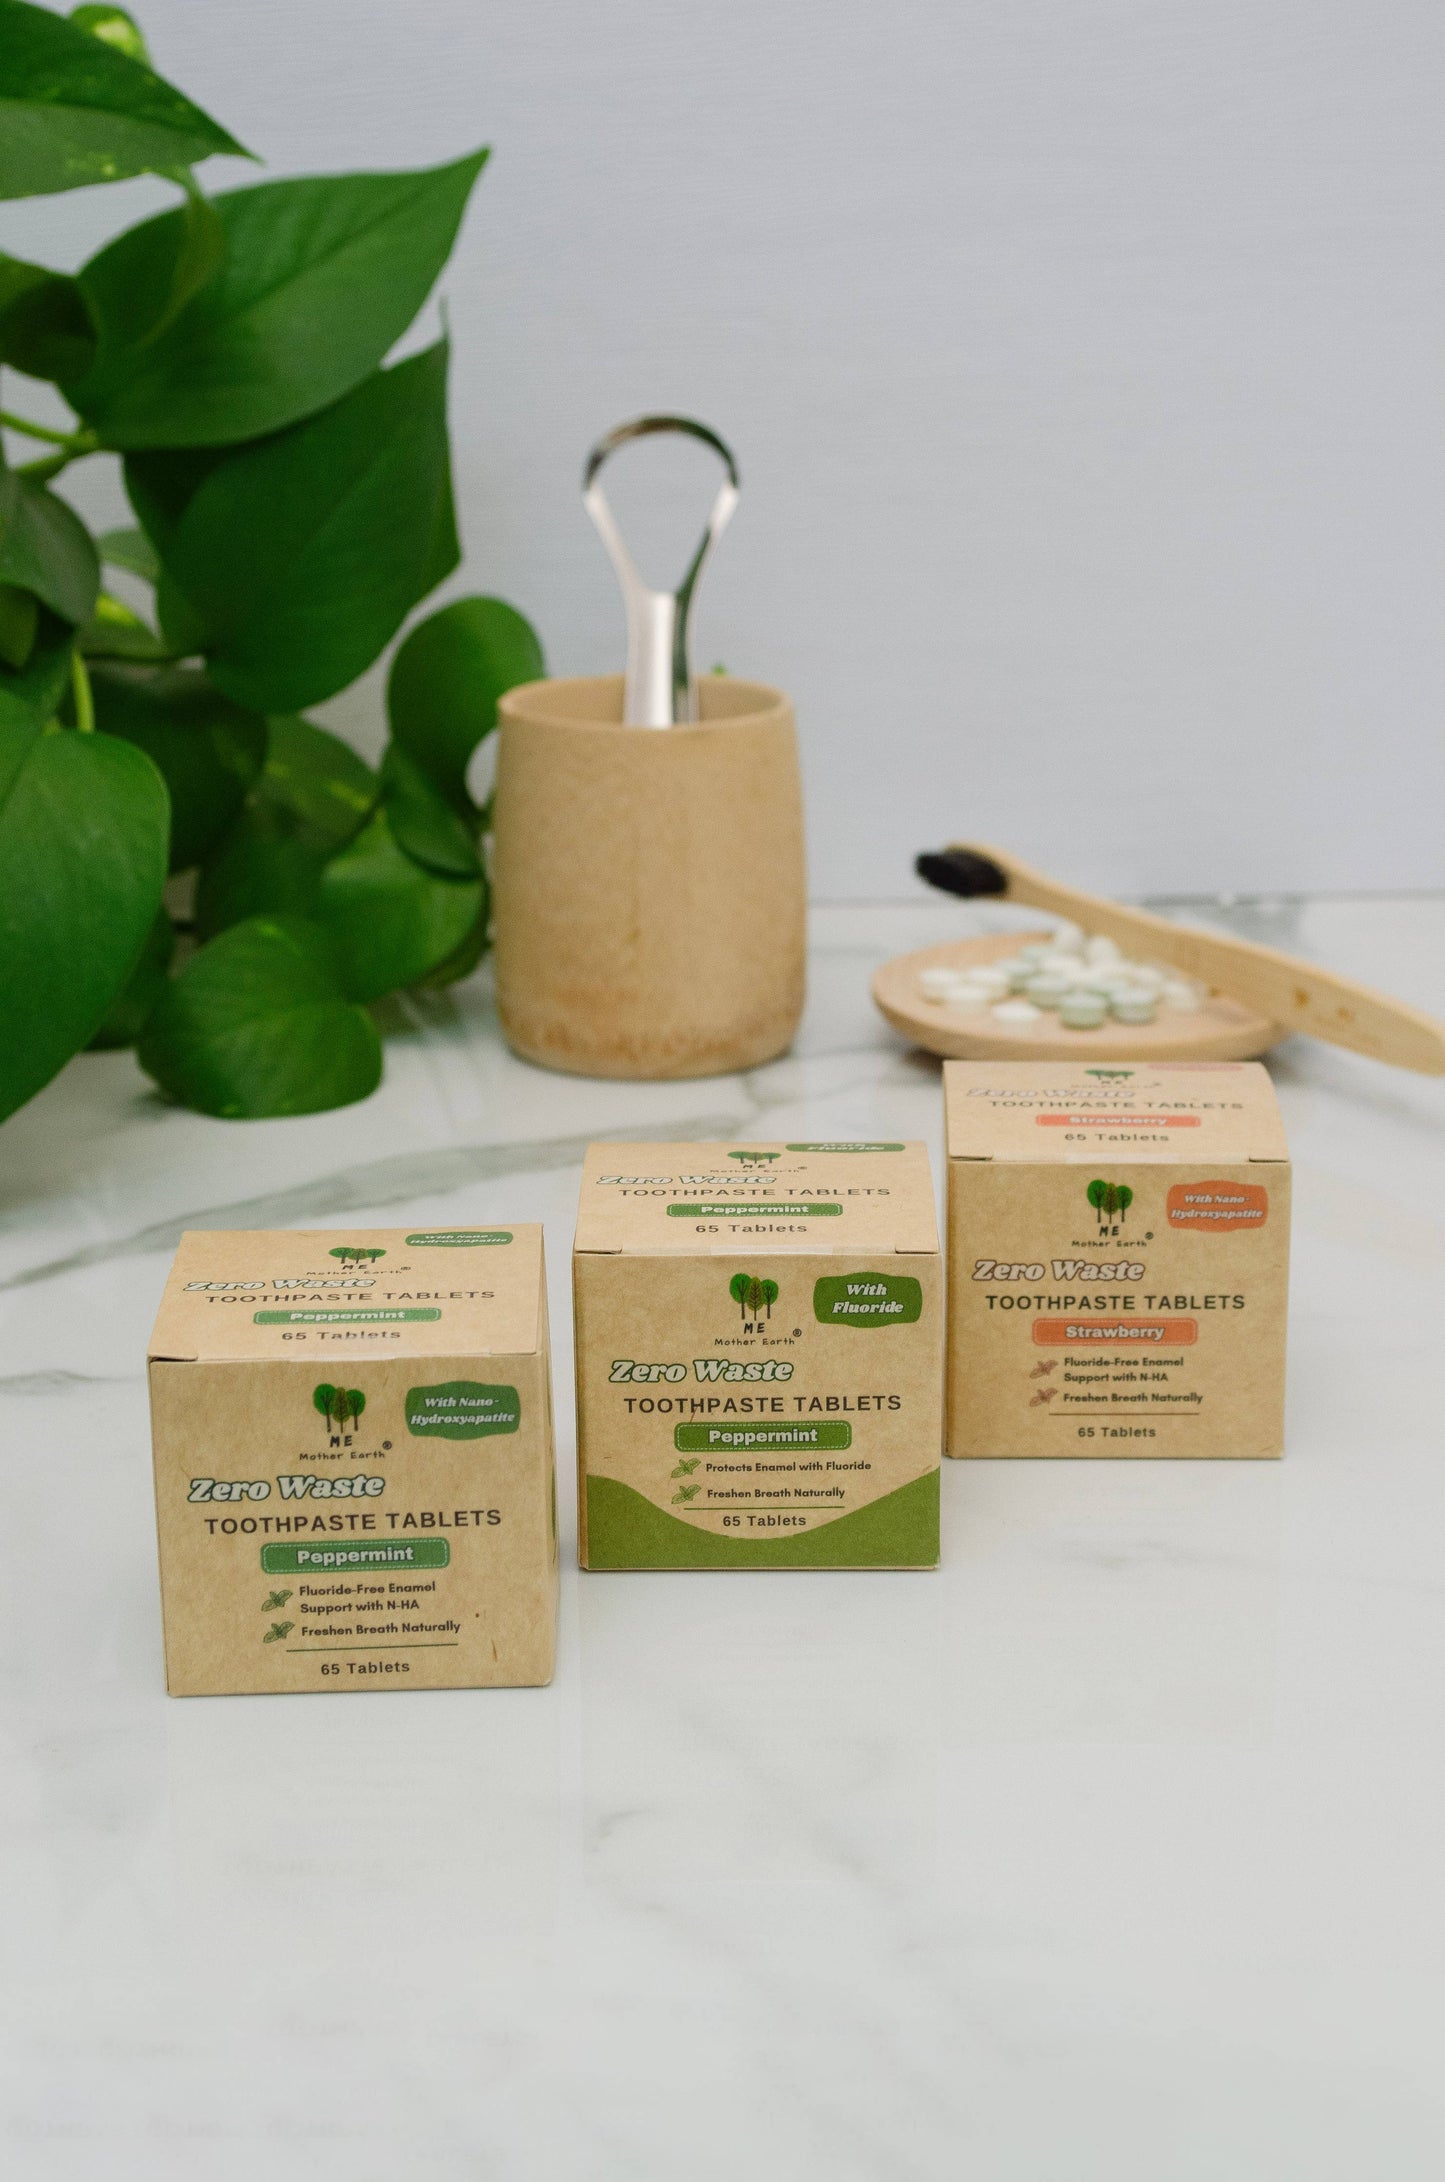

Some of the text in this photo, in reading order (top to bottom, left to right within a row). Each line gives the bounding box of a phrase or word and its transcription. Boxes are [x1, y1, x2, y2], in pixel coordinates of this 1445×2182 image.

[989, 1101, 1136, 1109] TOOTHPASTE
[1069, 1117, 1168, 1127] Strawberry
[596, 1175, 777, 1185] Zero Waste
[788, 1188, 891, 1196] TABLETS
[1184, 1194, 1214, 1204] With
[701, 1205, 809, 1215] Peppermint
[1171, 1208, 1263, 1220] Hydroxyapatite
[696, 1224, 808, 1233] 65 Tablets
[1072, 1240, 1147, 1248] Mother Earth
[971, 1259, 1145, 1281] Zero Waste
[183, 1277, 377, 1292] Zero Waste
[846, 1283, 888, 1297] With
[205, 1291, 495, 1304] TOOTHPASTE TABLETS
[985, 1295, 1245, 1310] TOOTHPASTE TABLETS
[832, 1301, 904, 1314] Fluoride
[290, 1310, 406, 1322] Peppermint
[744, 1323, 765, 1334] ME
[1065, 1325, 1166, 1341] Strawberry
[281, 1330, 401, 1341] 65 Tablets
[714, 1337, 795, 1346] Mother Earth
[1064, 1357, 1184, 1367] Fluoride-Free Enamel
[608, 1359, 794, 1383] Zero Waste
[1064, 1373, 1168, 1384] Support with N-HA
[424, 1396, 457, 1407] With
[624, 1395, 902, 1413] TOOTHPASTE TABLETS
[1064, 1392, 1203, 1404] Freshen Breath Naturally
[411, 1411, 515, 1426] Hydroxyapatite
[708, 1428, 818, 1445] Peppermint
[1078, 1427, 1156, 1438] 65 Tablets
[330, 1435, 353, 1448] ME
[299, 1451, 385, 1460] Mother Earth
[706, 1460, 872, 1473] Protects Enamel with Fluoride
[187, 1474, 385, 1503] Zero Waste
[707, 1487, 845, 1500] Freshen Breath Naturally
[205, 1509, 502, 1535] TOOTHPASTE TABLETS
[723, 1515, 807, 1527] 65 Tablets
[296, 1547, 414, 1566] Peppermint
[299, 1582, 436, 1597] Fluoride-Free Enamel
[300, 1600, 420, 1615] Support with N-HA
[301, 1621, 461, 1637] Freshen Breath Naturally
[321, 1661, 410, 1675] 65 Tablets
